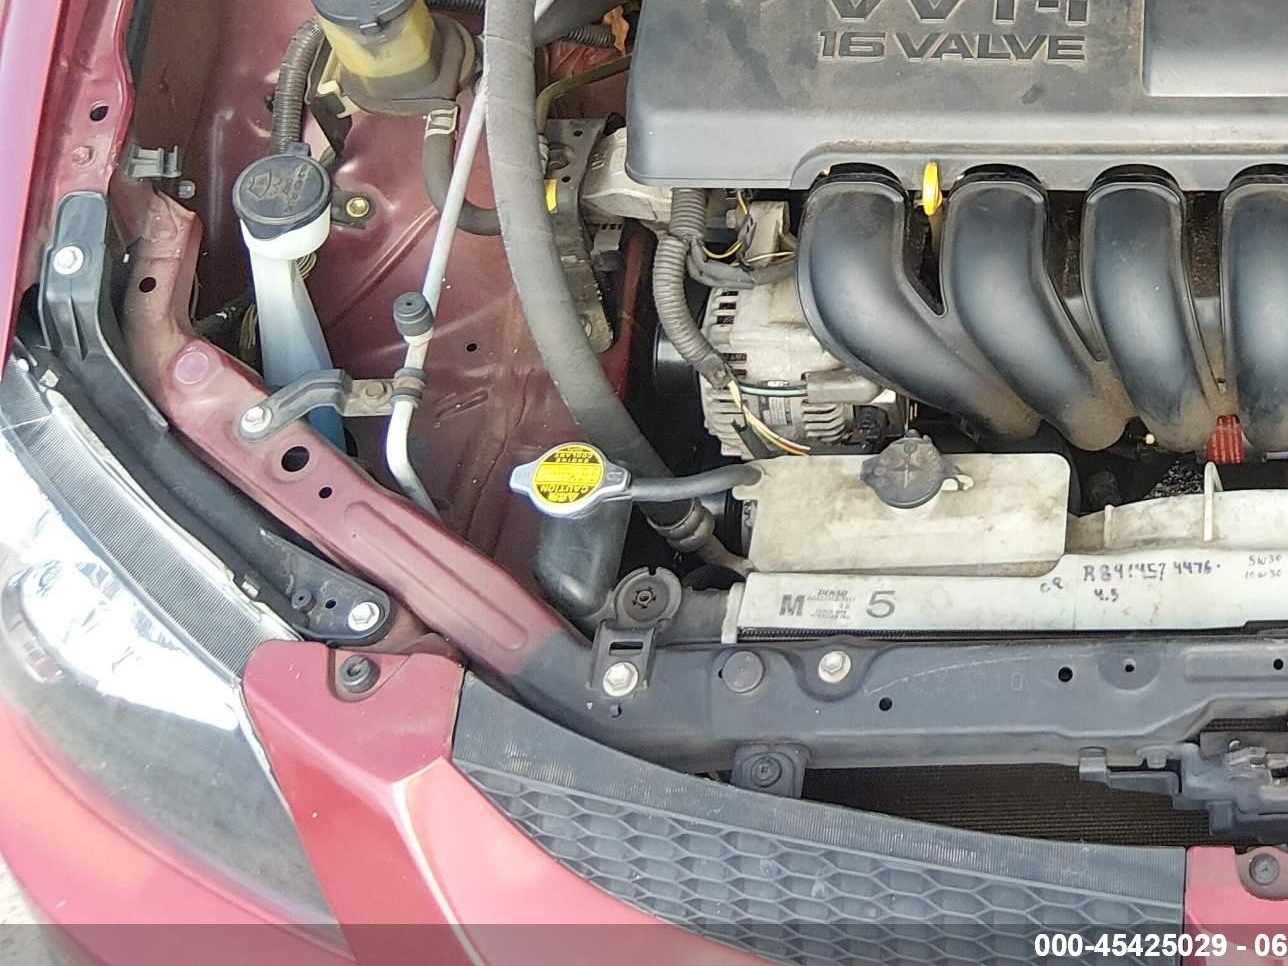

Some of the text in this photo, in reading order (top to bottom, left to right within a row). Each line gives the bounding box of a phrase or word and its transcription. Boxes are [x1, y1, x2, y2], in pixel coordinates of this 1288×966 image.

[818, 30, 1089, 63] 16 VALVE
[539, 483, 589, 494] CAUTION
[866, 590, 896, 618] 5
